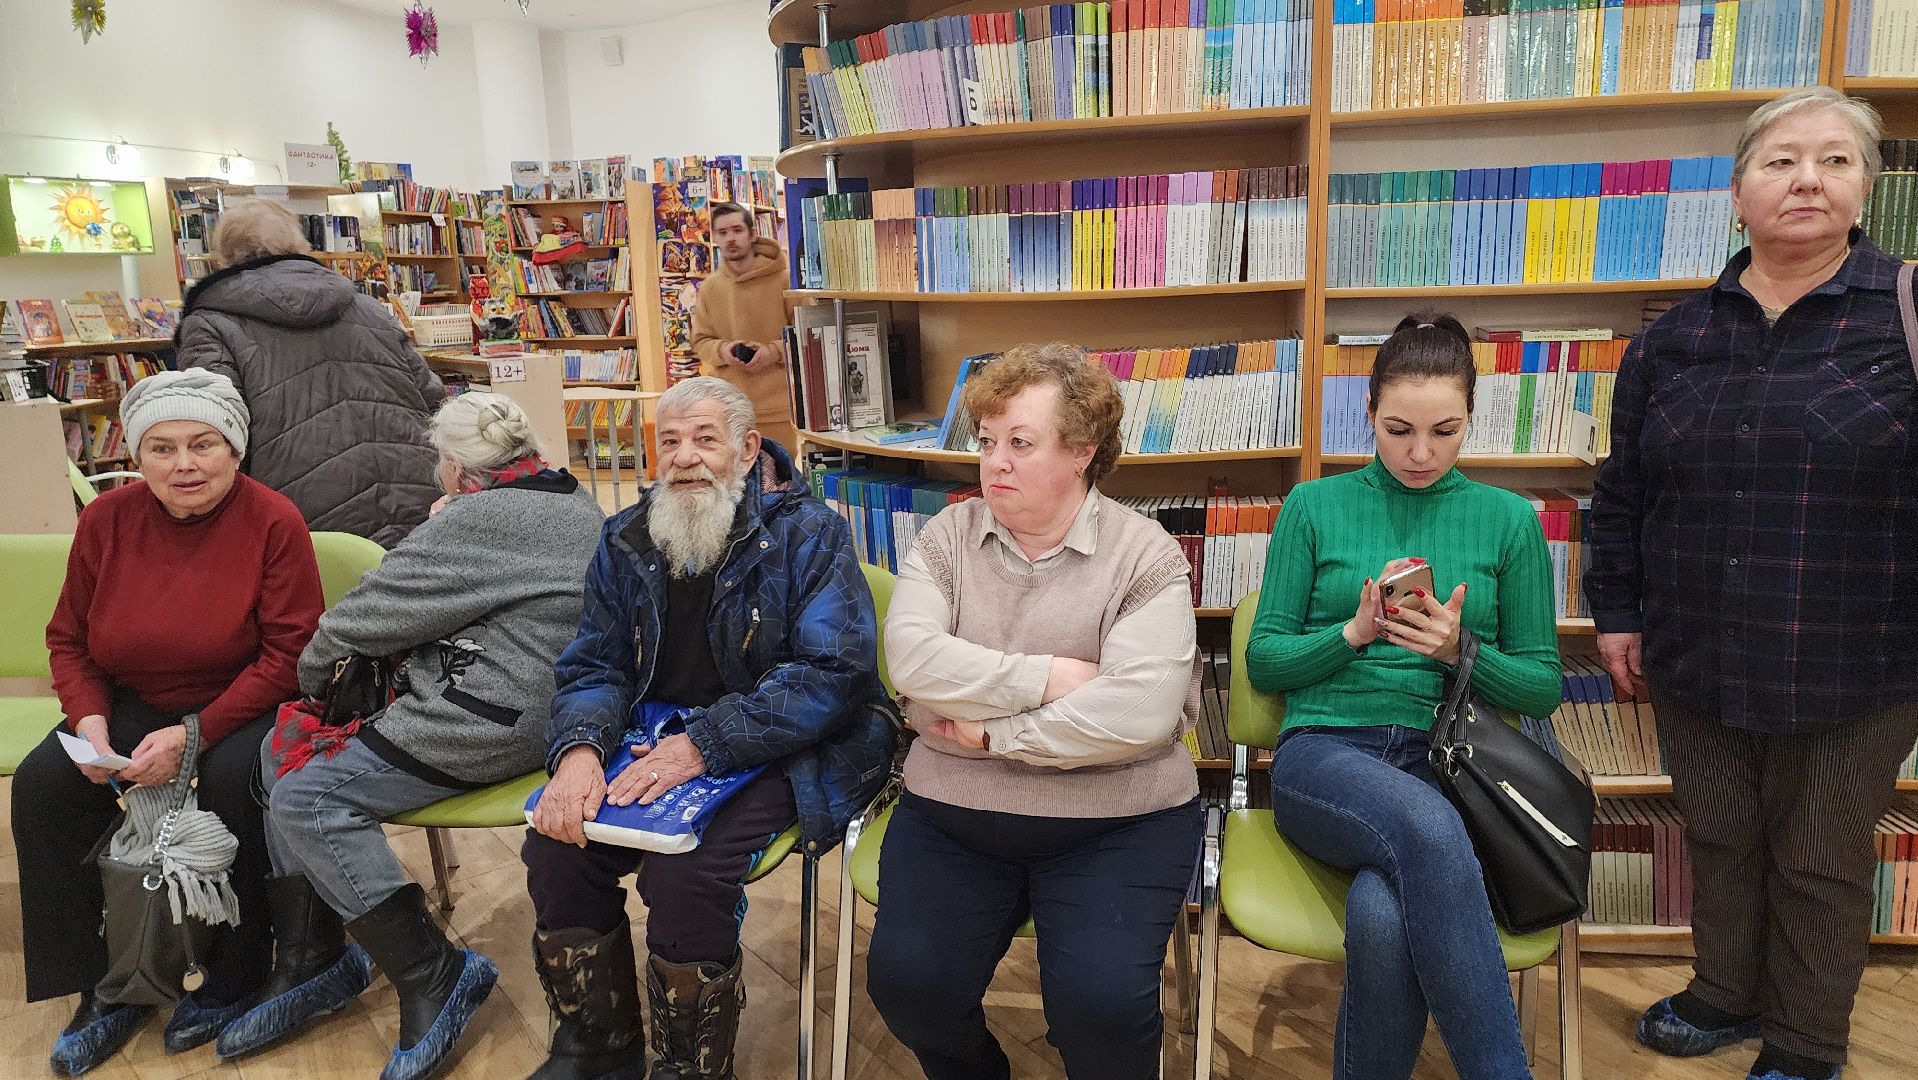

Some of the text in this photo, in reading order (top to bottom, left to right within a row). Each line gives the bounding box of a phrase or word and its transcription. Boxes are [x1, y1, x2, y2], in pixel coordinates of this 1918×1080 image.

[288, 151, 335, 160] ФАНТАСТИКА
[692, 186, 704, 195] 6+
[495, 365, 522, 379] 12+
